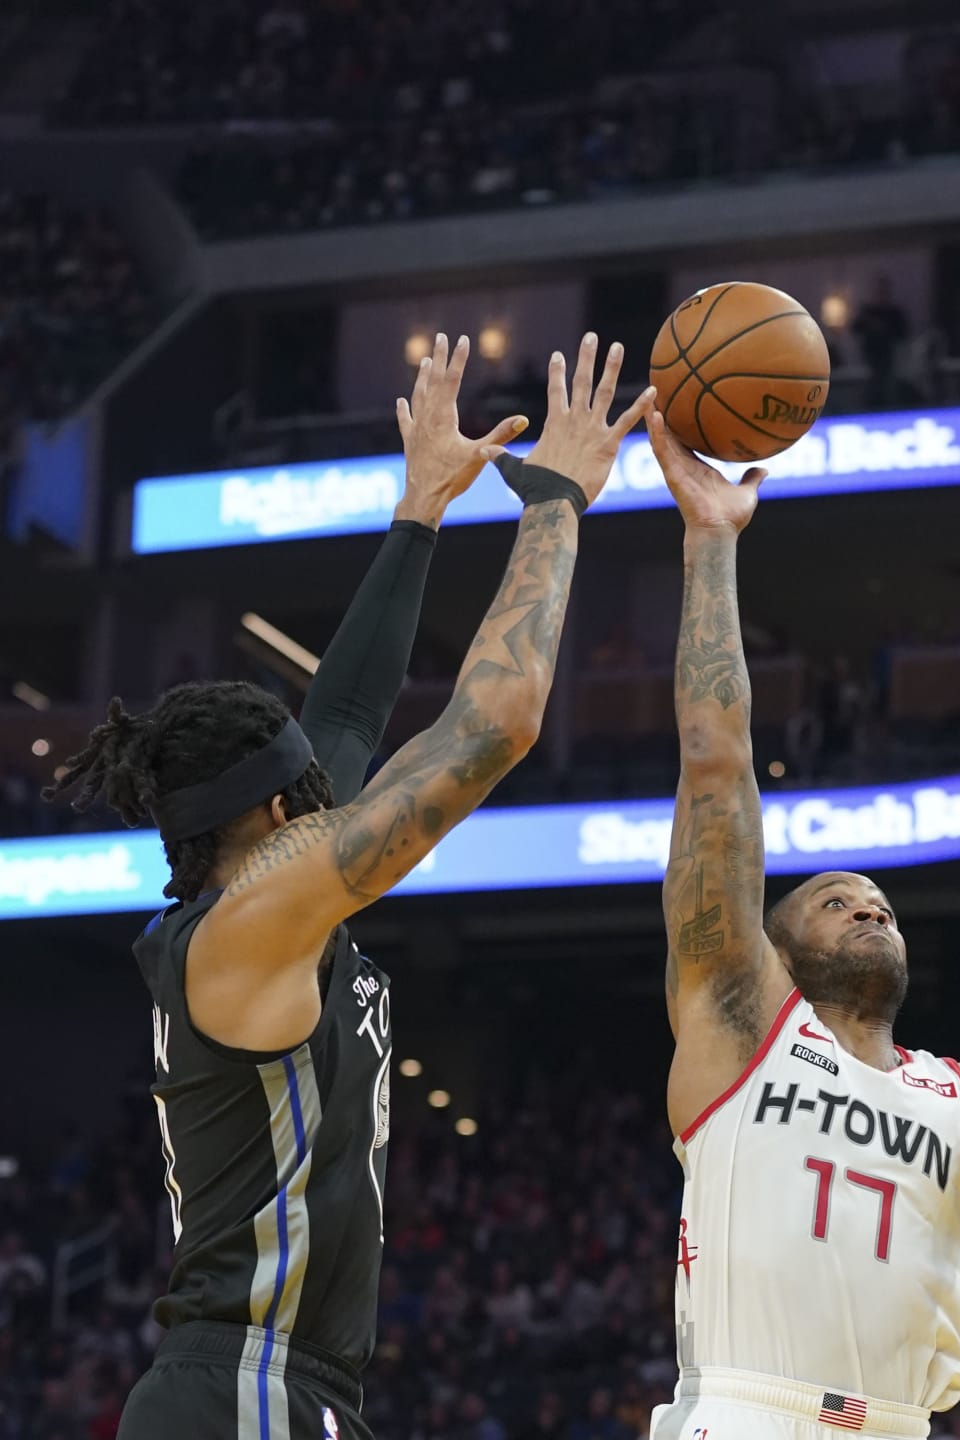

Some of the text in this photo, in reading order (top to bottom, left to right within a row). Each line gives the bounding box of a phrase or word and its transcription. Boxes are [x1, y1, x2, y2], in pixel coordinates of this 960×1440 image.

[753, 393, 824, 425] SPALD
[219, 468, 399, 537] Rakuten
[578, 812, 673, 869] Sho
[790, 795, 913, 853] Cash
[0, 844, 141, 906] epeat.
[352, 975, 380, 1008] The
[356, 986, 391, 1059] TO
[795, 1045, 837, 1074] ROCKETS
[752, 1081, 952, 1194] H-TOWN
[804, 1154, 898, 1265] 17
